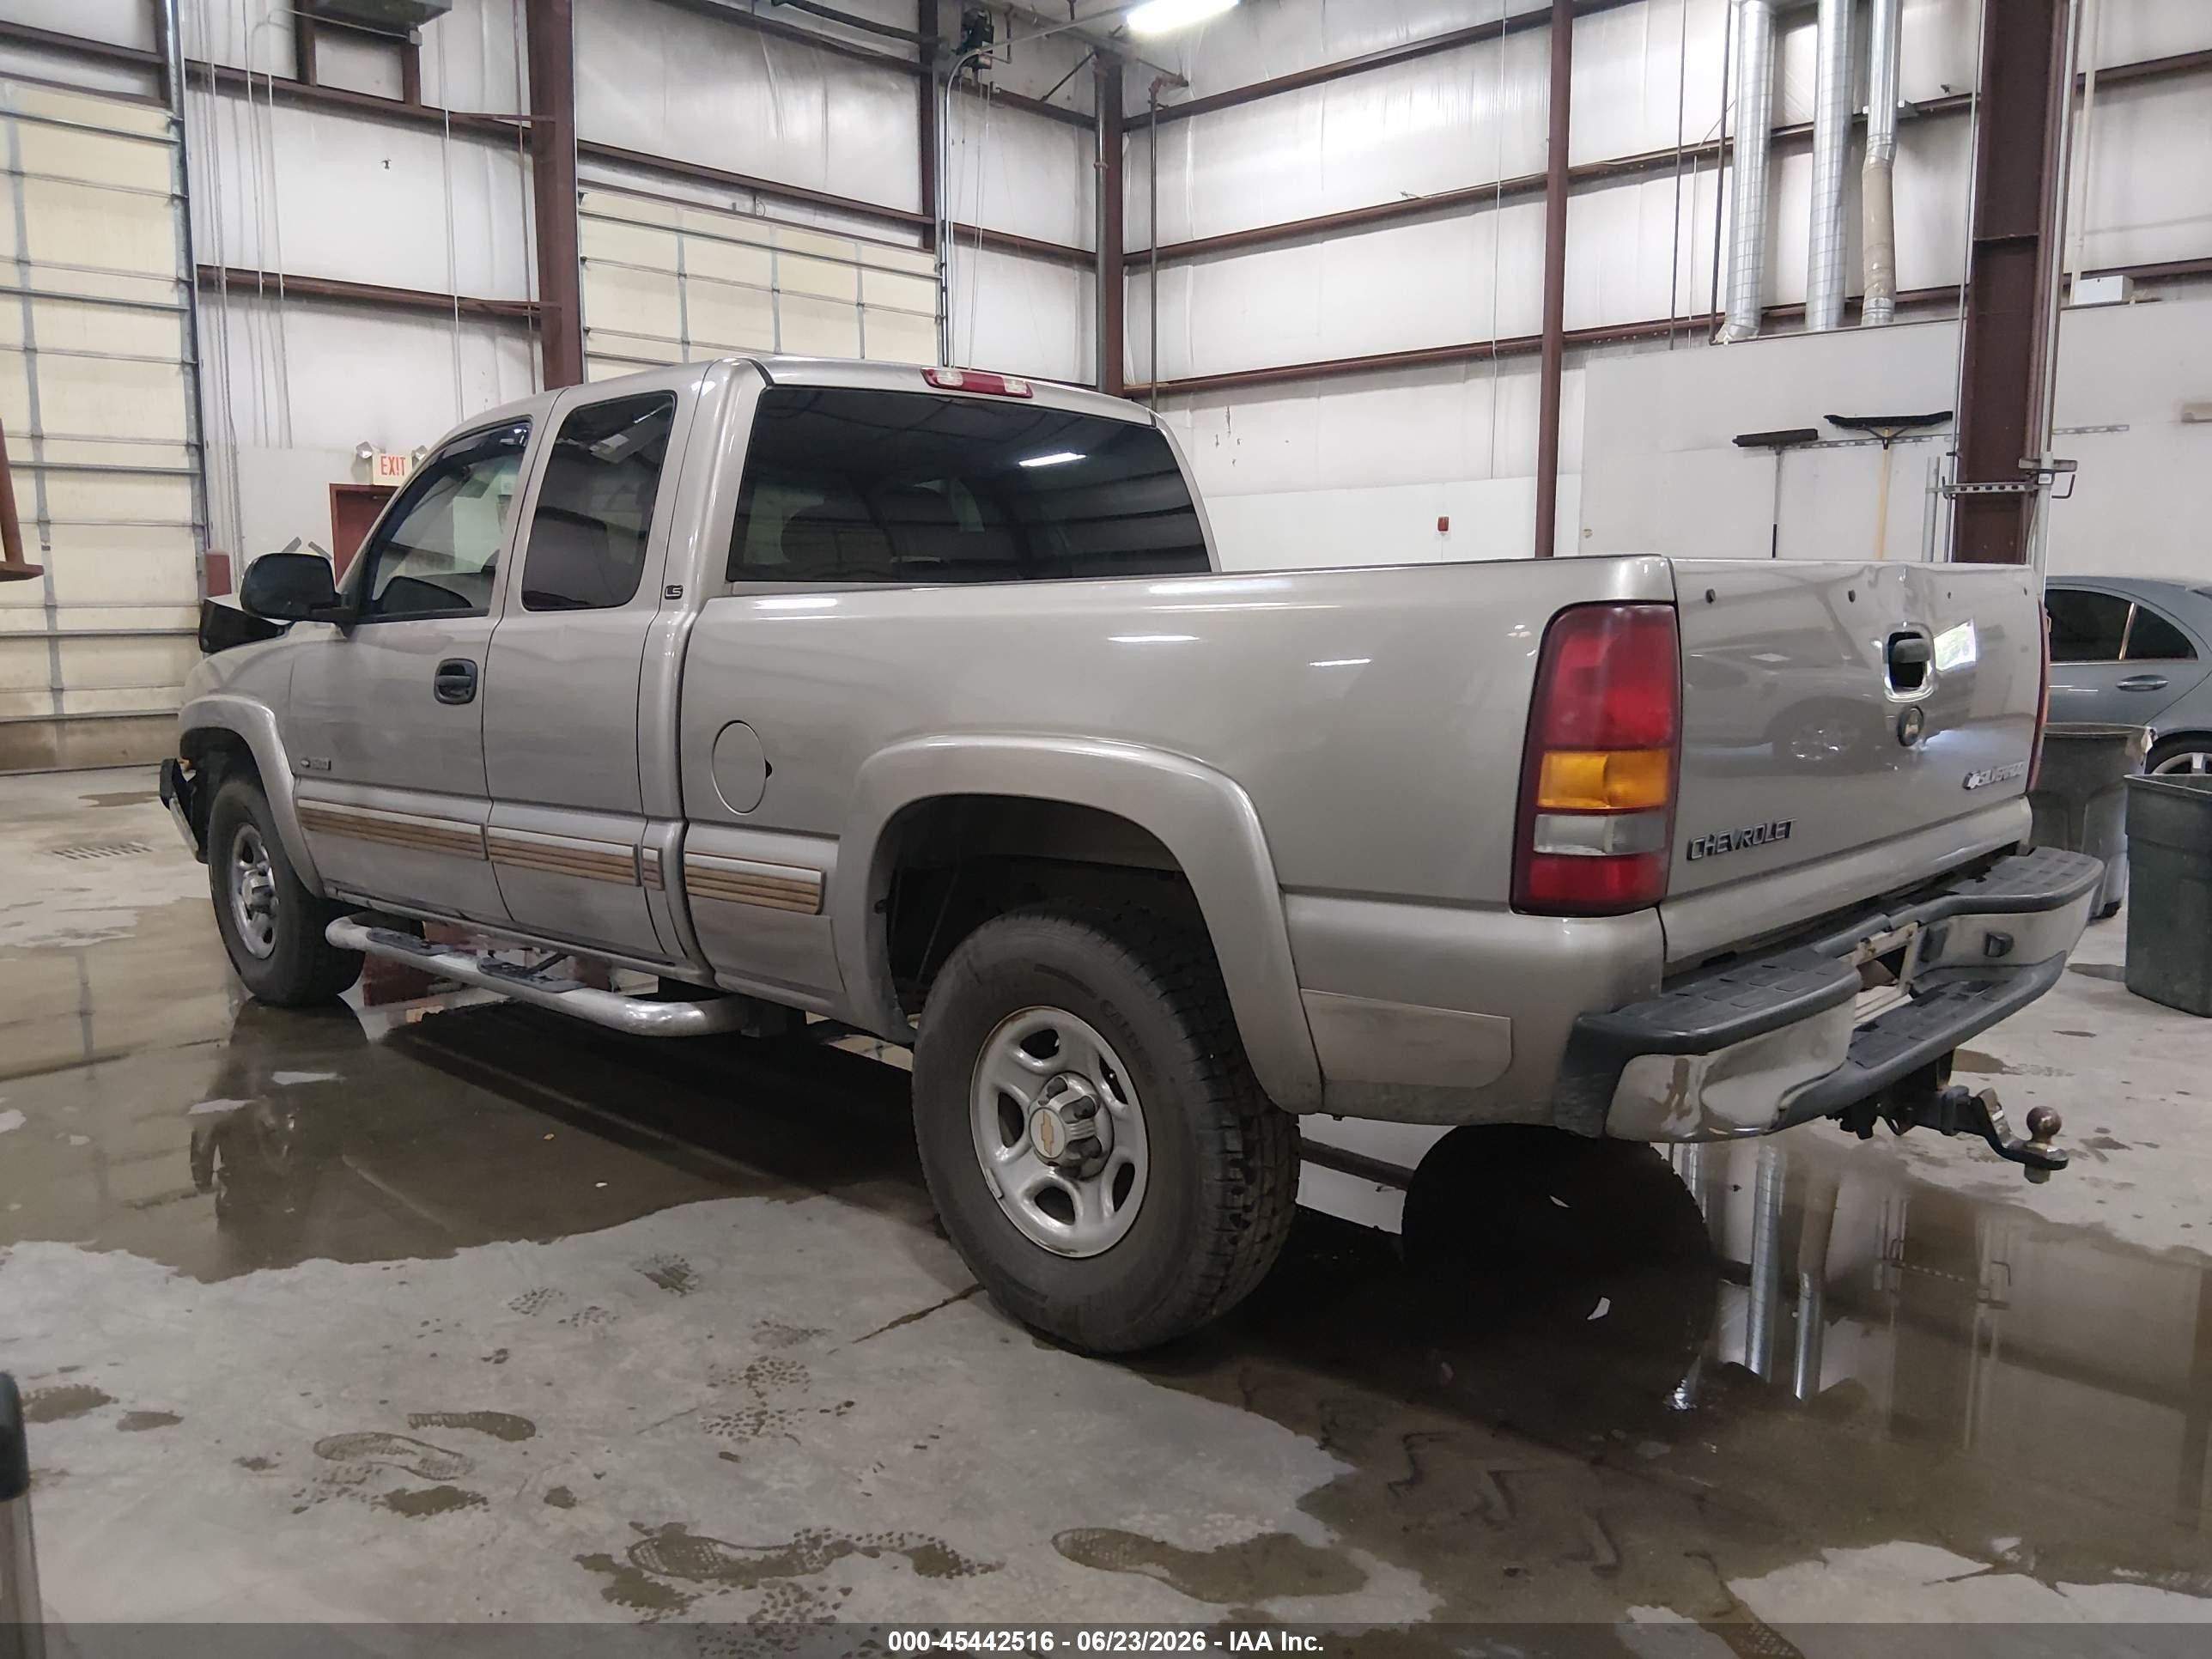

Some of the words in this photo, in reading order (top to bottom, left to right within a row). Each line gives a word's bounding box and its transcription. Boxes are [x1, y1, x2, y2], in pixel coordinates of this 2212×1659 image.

[380, 456, 406, 477] EXIT
[665, 587, 683, 598] LS
[1686, 817, 1798, 861] CHEVROLET
